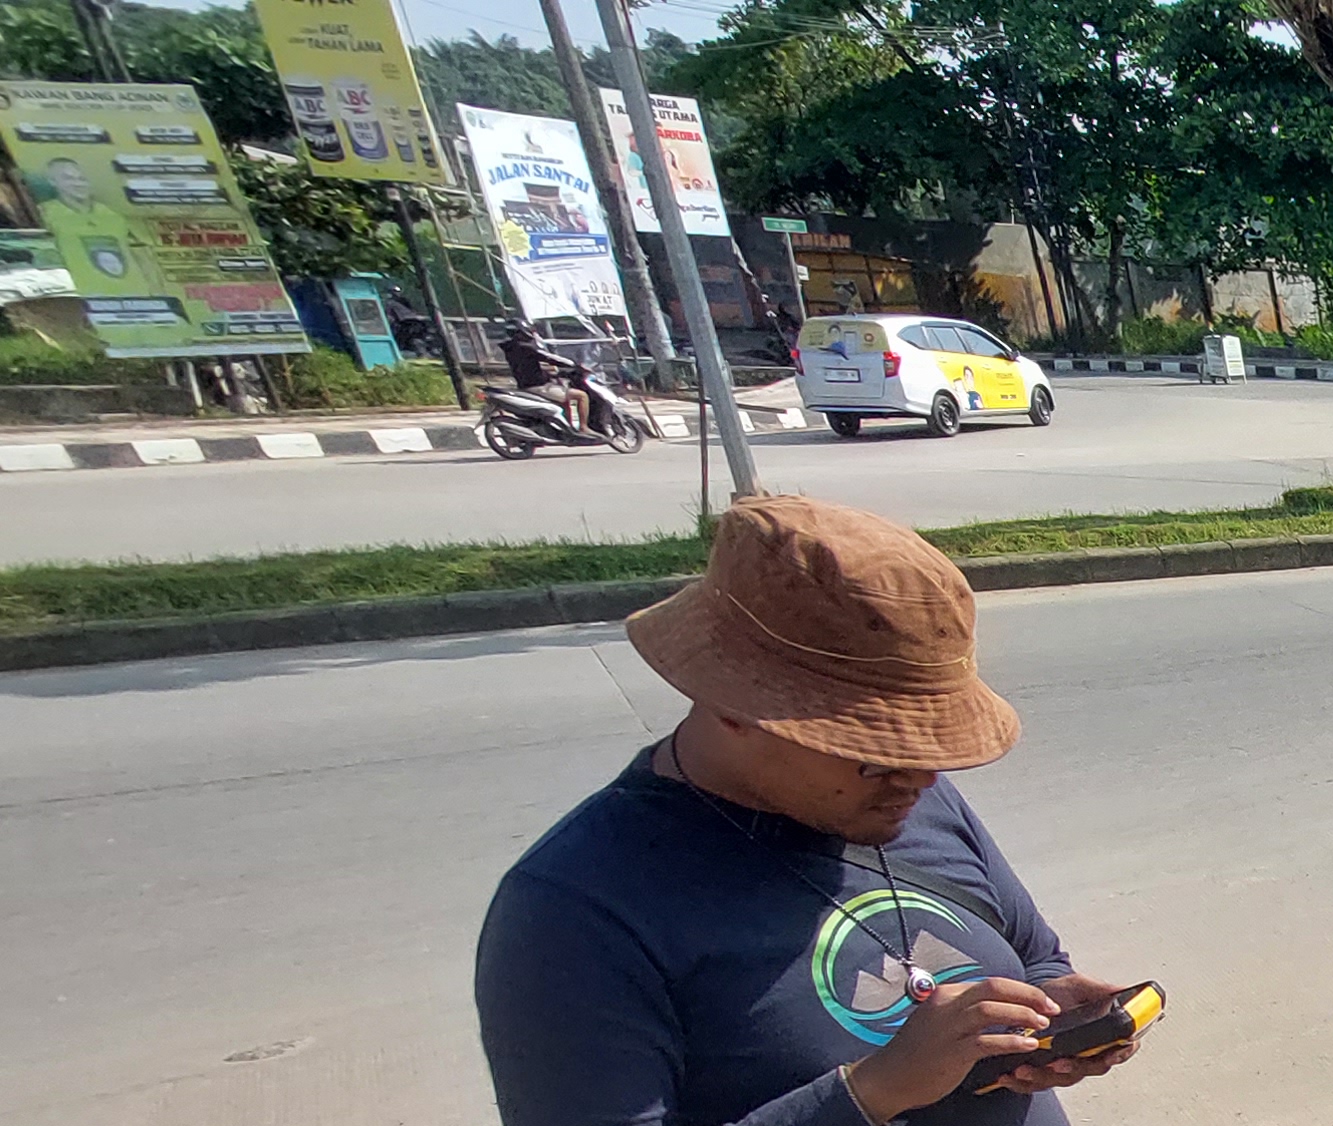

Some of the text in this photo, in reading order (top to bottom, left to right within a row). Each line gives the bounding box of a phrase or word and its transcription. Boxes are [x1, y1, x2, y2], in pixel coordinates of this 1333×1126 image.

[295, 97, 327, 113] ABC
[336, 89, 371, 106] ABC
[658, 110, 698, 123] UTAMA
[656, 129, 703, 143] ARKOBA
[488, 162, 590, 194] JALAN SANTAI
